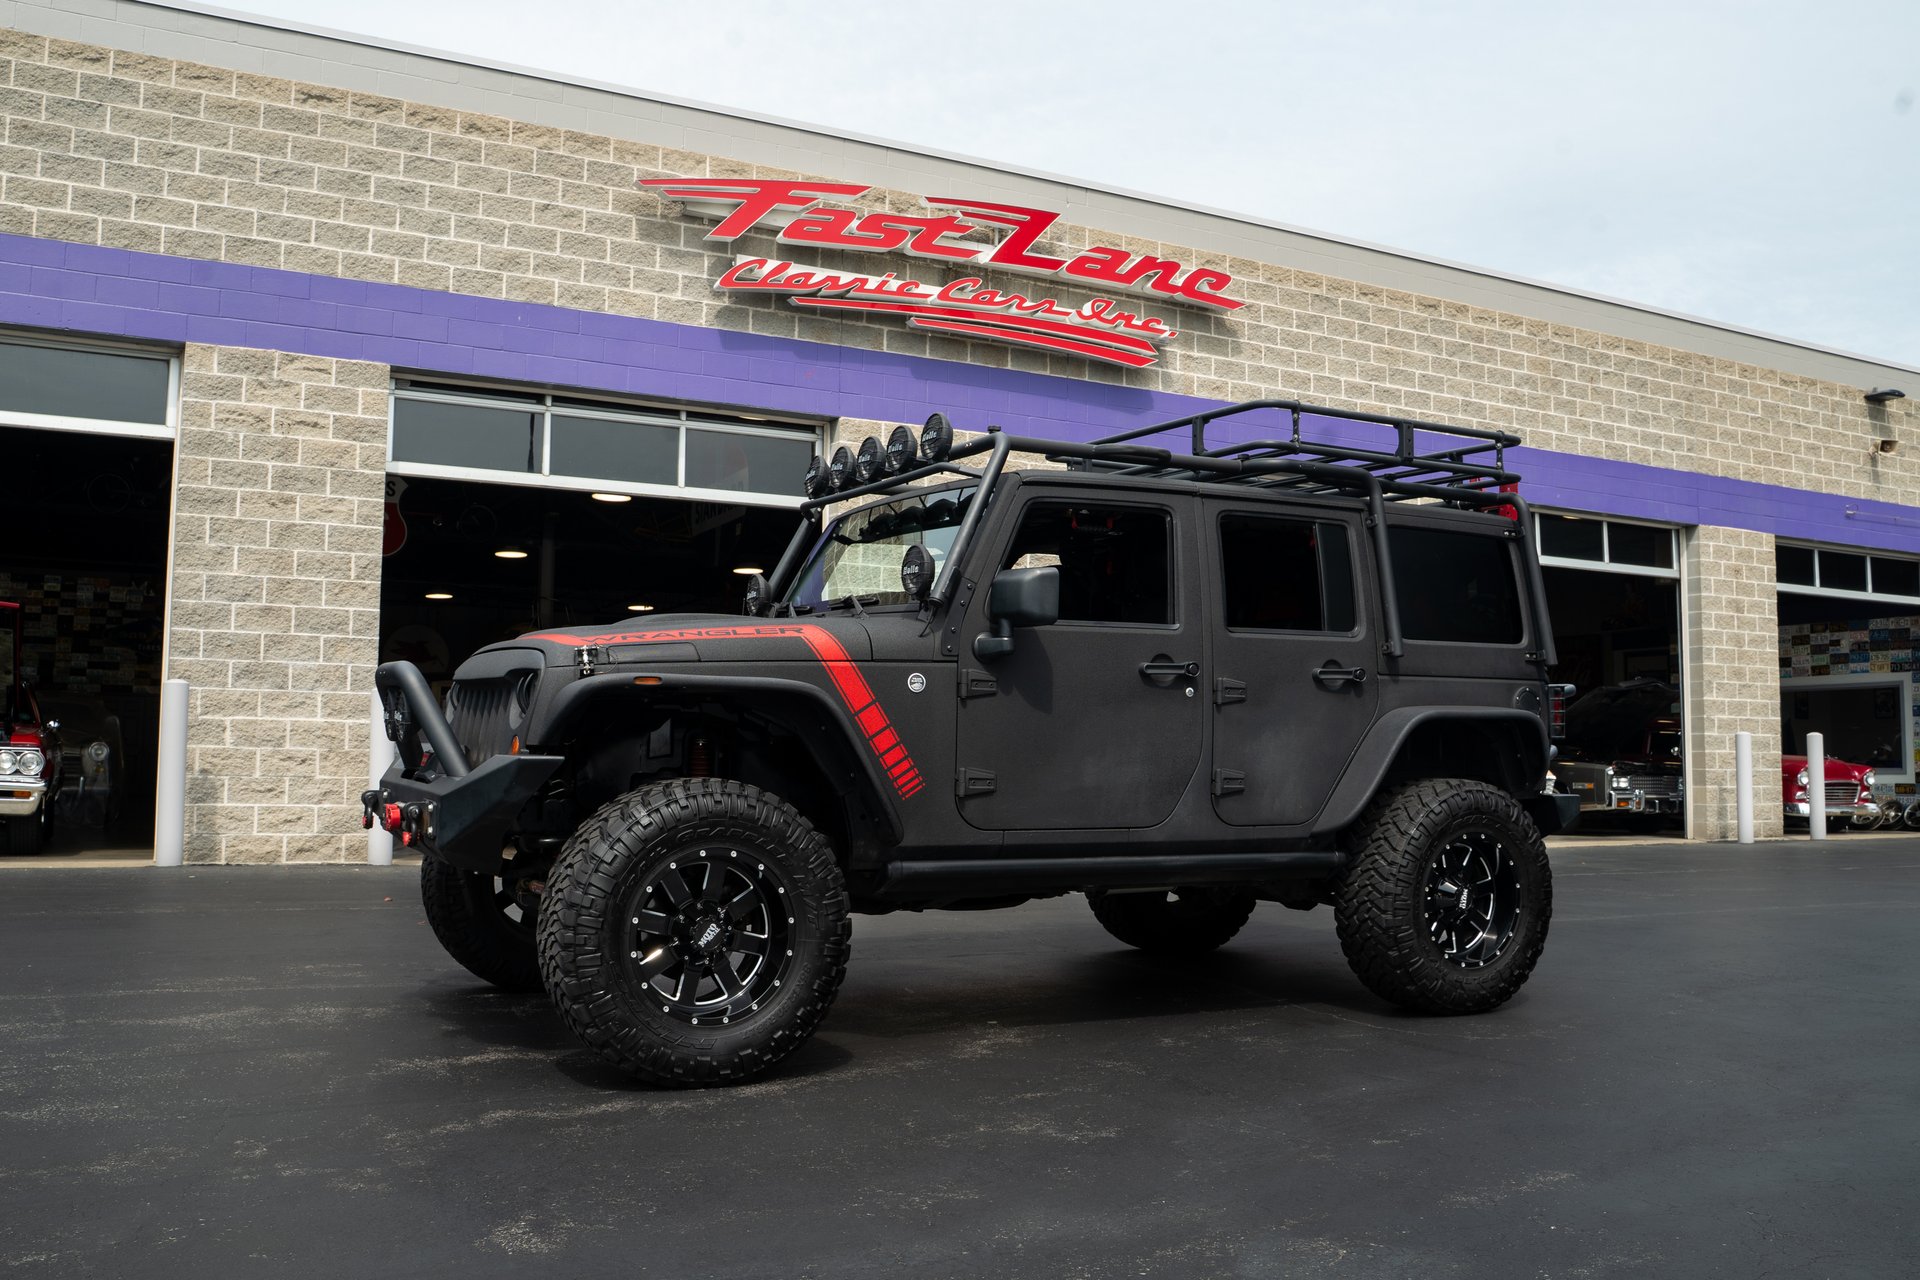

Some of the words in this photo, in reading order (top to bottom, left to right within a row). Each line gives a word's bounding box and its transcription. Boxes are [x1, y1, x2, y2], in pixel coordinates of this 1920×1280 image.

[637, 178, 980, 258] Fast
[922, 196, 1246, 309] Lane
[718, 258, 937, 297] Classic
[936, 277, 1073, 318] Cars
[582, 627, 804, 643] WRANGLER
[698, 923, 717, 948] MOTO
